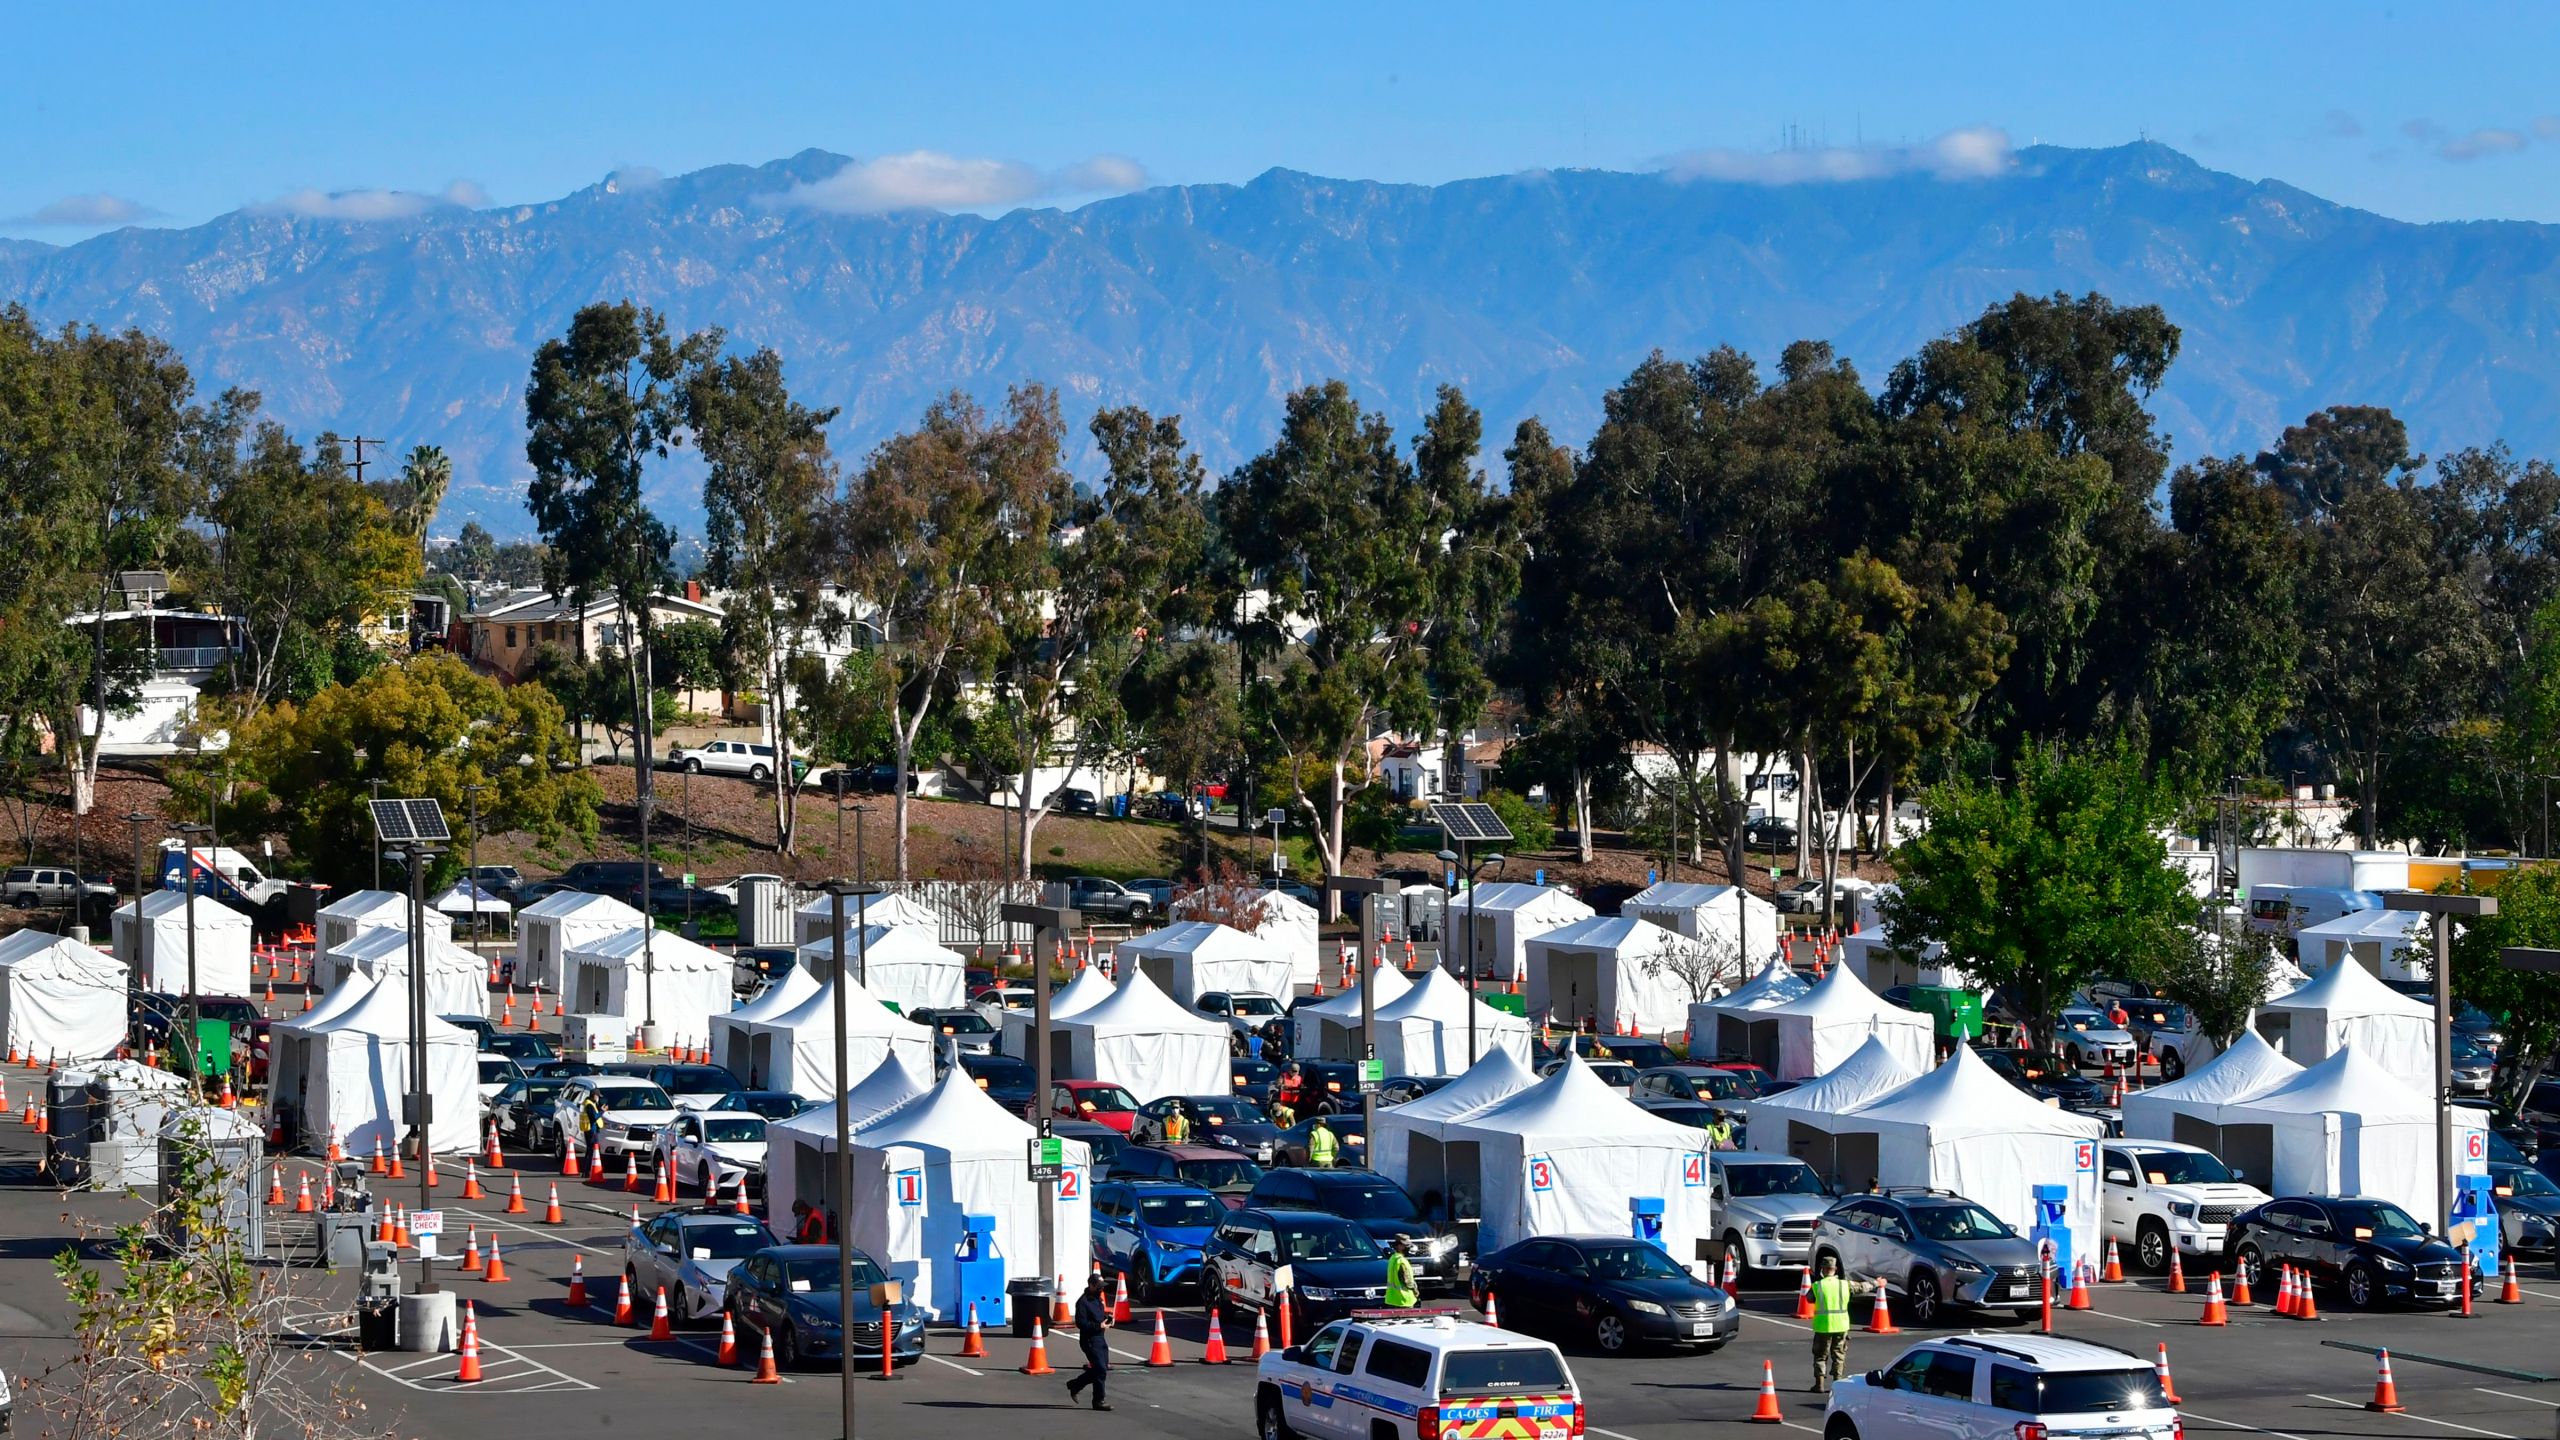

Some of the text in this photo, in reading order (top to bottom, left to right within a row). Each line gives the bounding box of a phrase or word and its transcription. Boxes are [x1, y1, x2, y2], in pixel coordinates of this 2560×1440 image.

[2079, 1145, 2091, 1168] 5
[2469, 1135, 2481, 1157] 6
[1033, 1167, 1052, 1175] 1476
[1534, 1163, 1549, 1187] 3
[1686, 1158, 1700, 1182] 4
[901, 1176, 917, 1201] 1
[1061, 1171, 1076, 1196] 2
[1447, 1404, 1560, 1419] CA-OES FIRE
